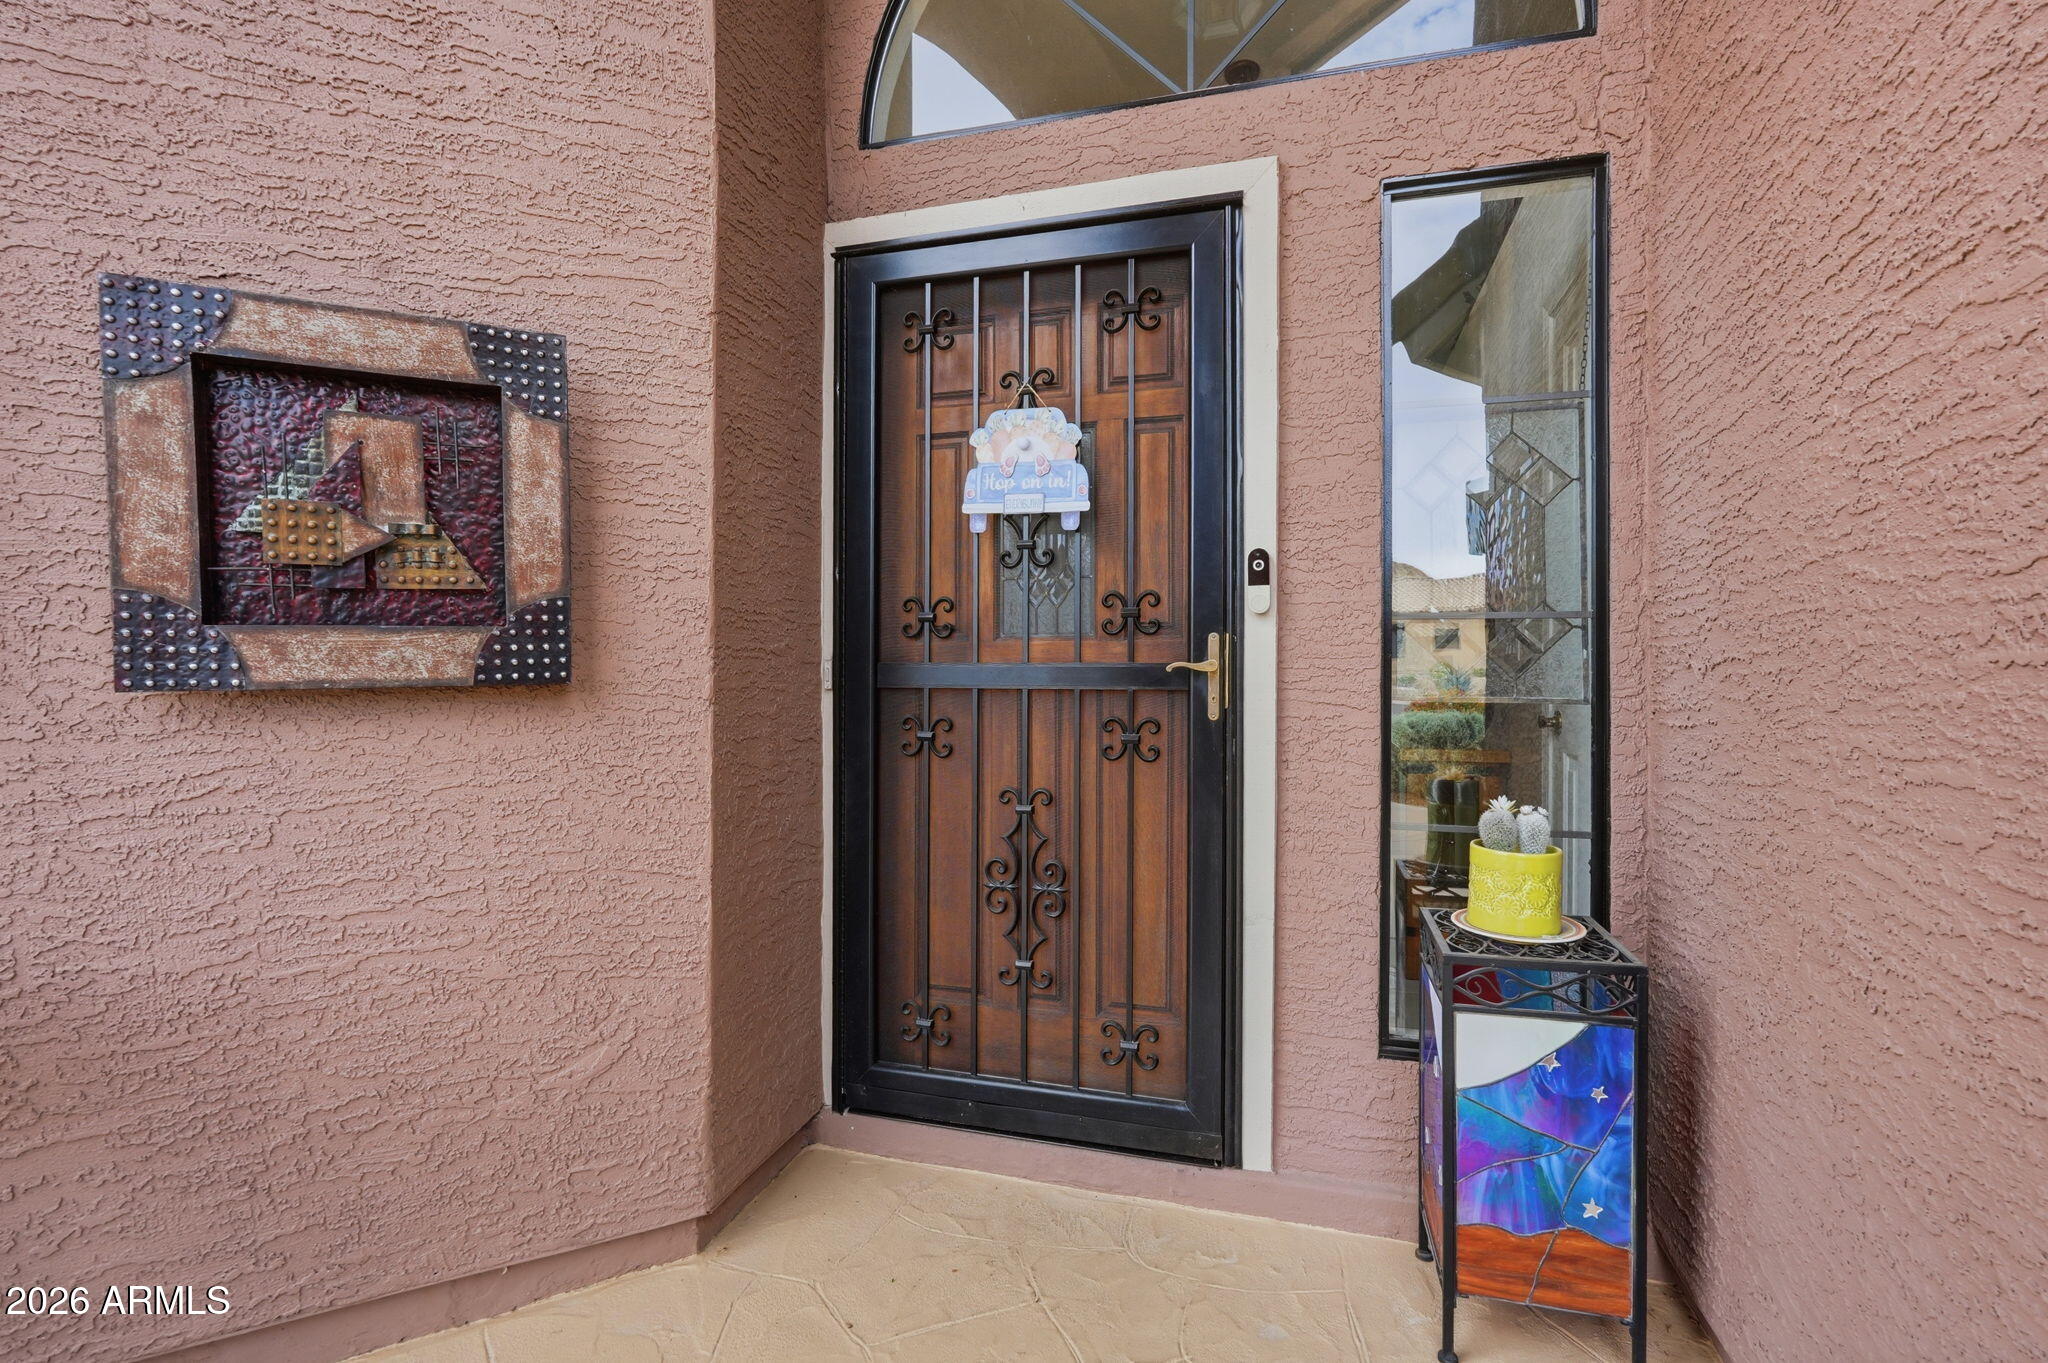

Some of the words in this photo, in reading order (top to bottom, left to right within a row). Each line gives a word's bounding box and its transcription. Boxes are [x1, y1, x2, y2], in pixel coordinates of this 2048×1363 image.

[983, 472, 1016, 493] Hop
[1021, 478, 1043, 489] on
[1048, 469, 1071, 489] in!
